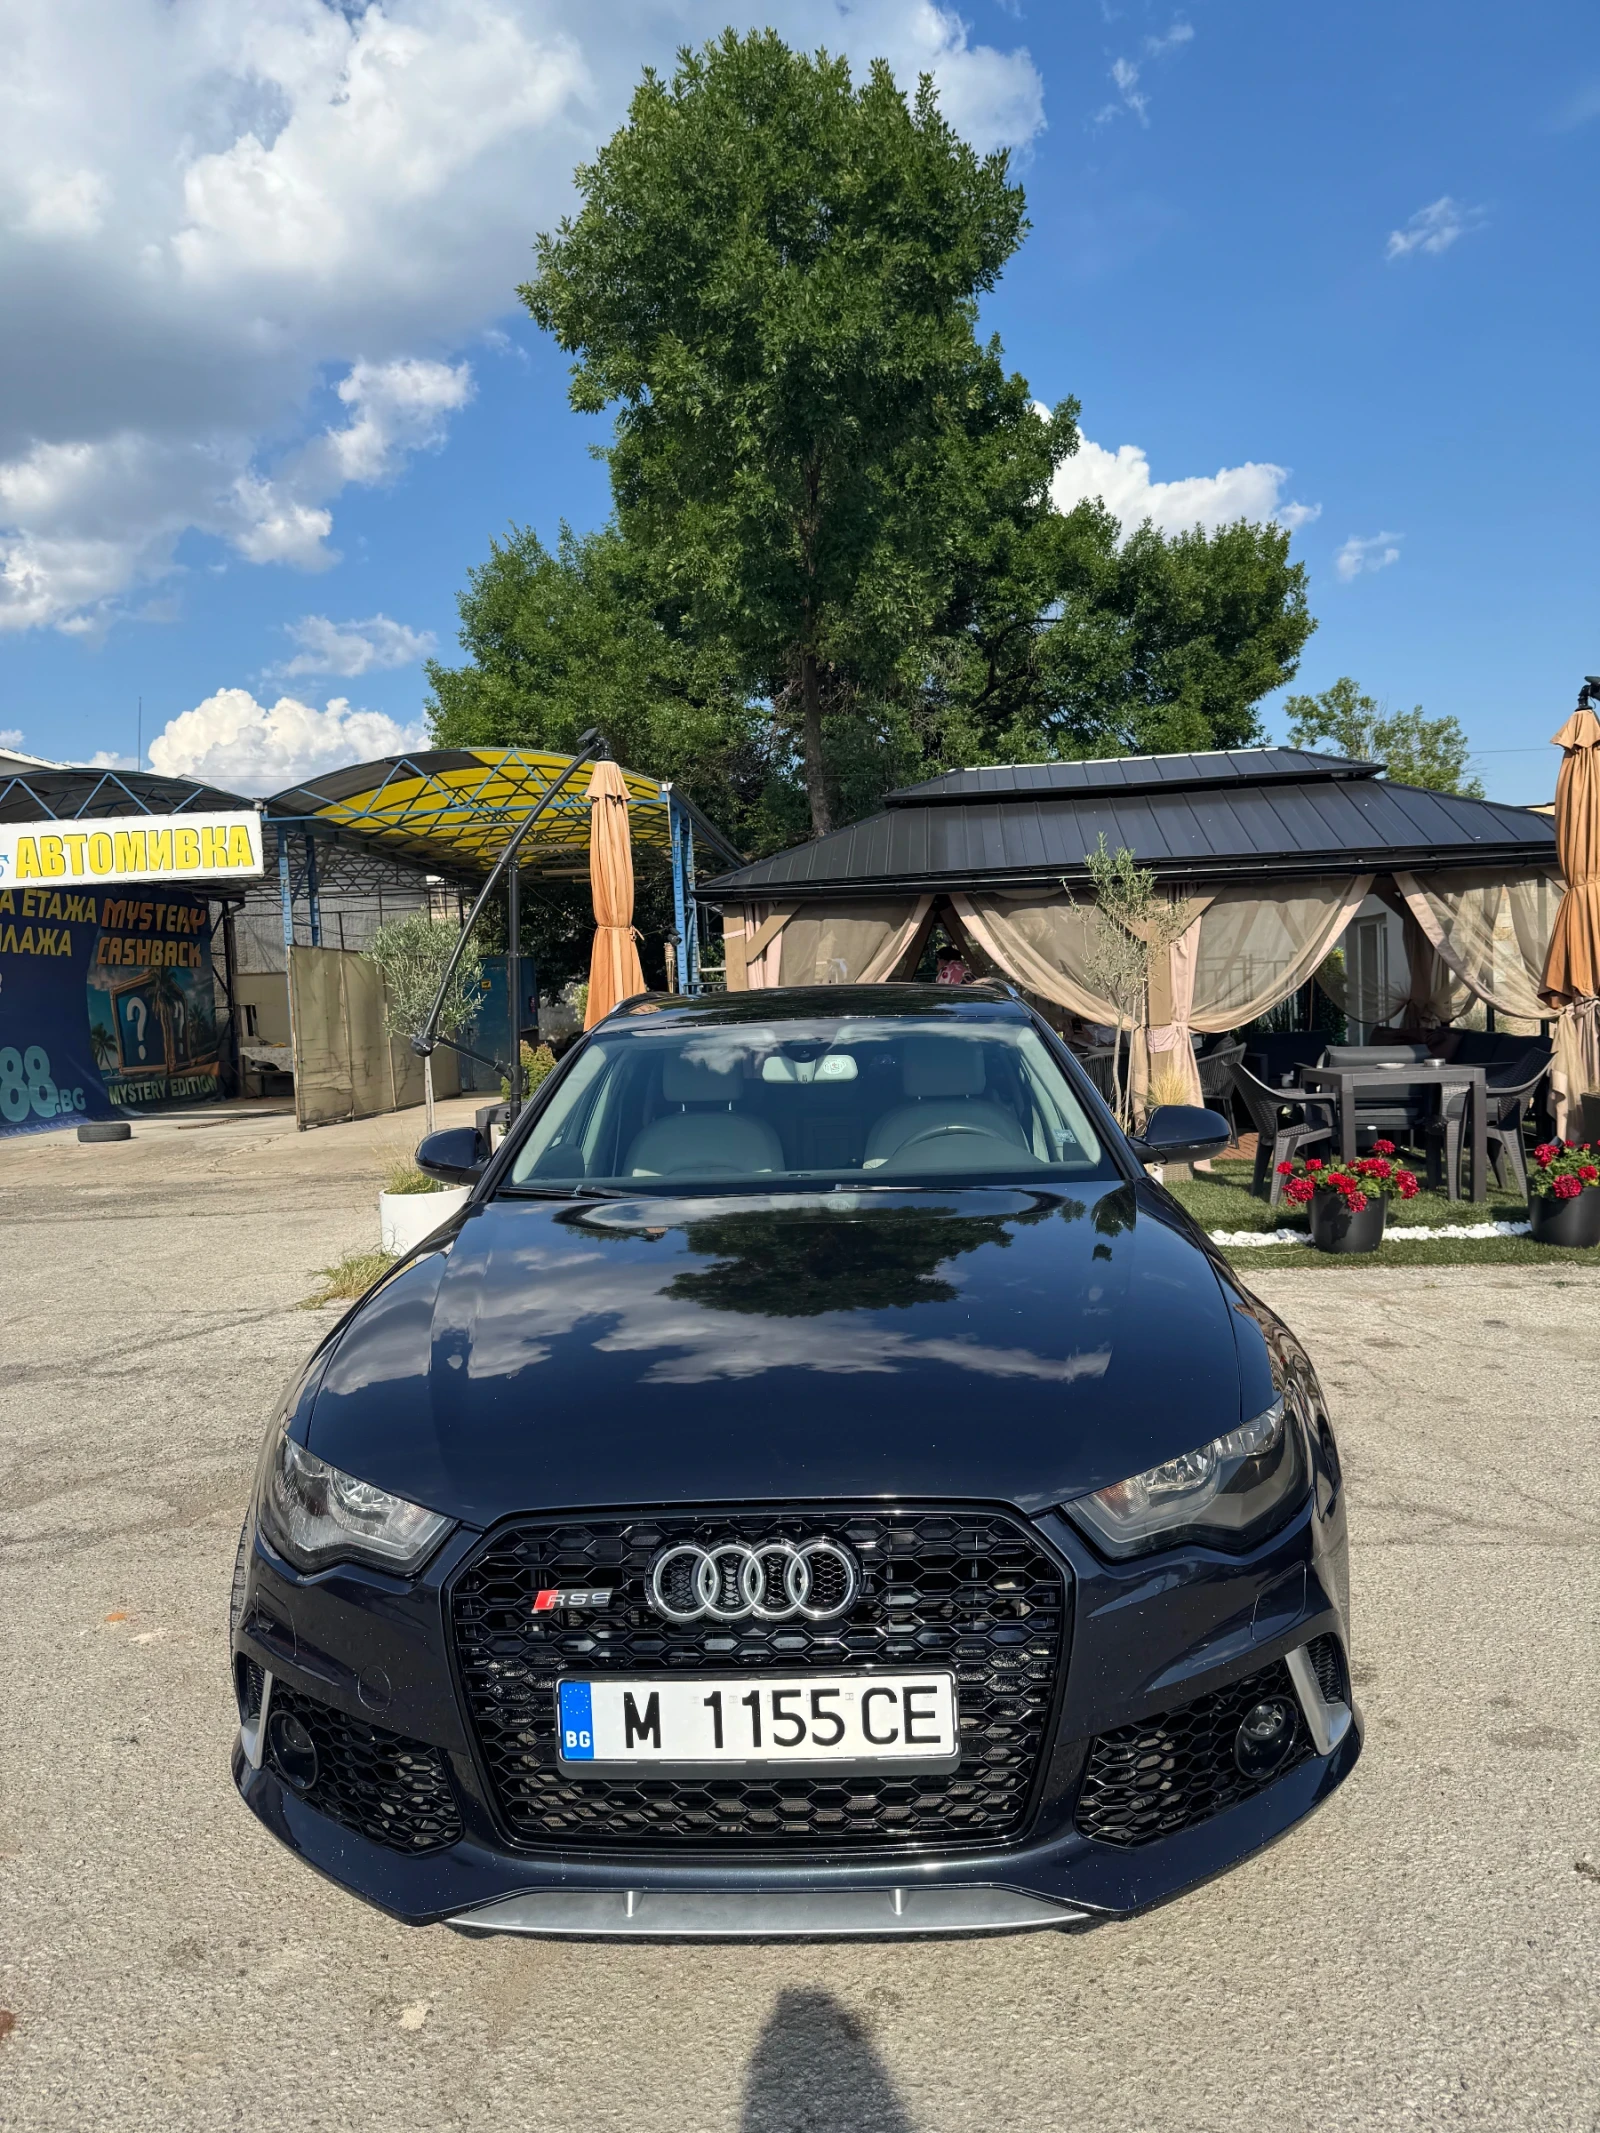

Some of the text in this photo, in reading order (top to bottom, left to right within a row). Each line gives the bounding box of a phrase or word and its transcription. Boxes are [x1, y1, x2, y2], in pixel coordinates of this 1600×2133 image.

[16, 825, 255, 879] АВТОМИВКА
[22, 888, 97, 923] ЕТАЖА
[101, 898, 206, 934] MYSTERY
[0, 922, 72, 957] ЛАЖА
[97, 937, 202, 967] CASHBACK
[108, 1075, 218, 1105] MYSTERY EDITION
[623, 1686, 941, 1749] M 1155 CE
[565, 1730, 591, 1748] BG
